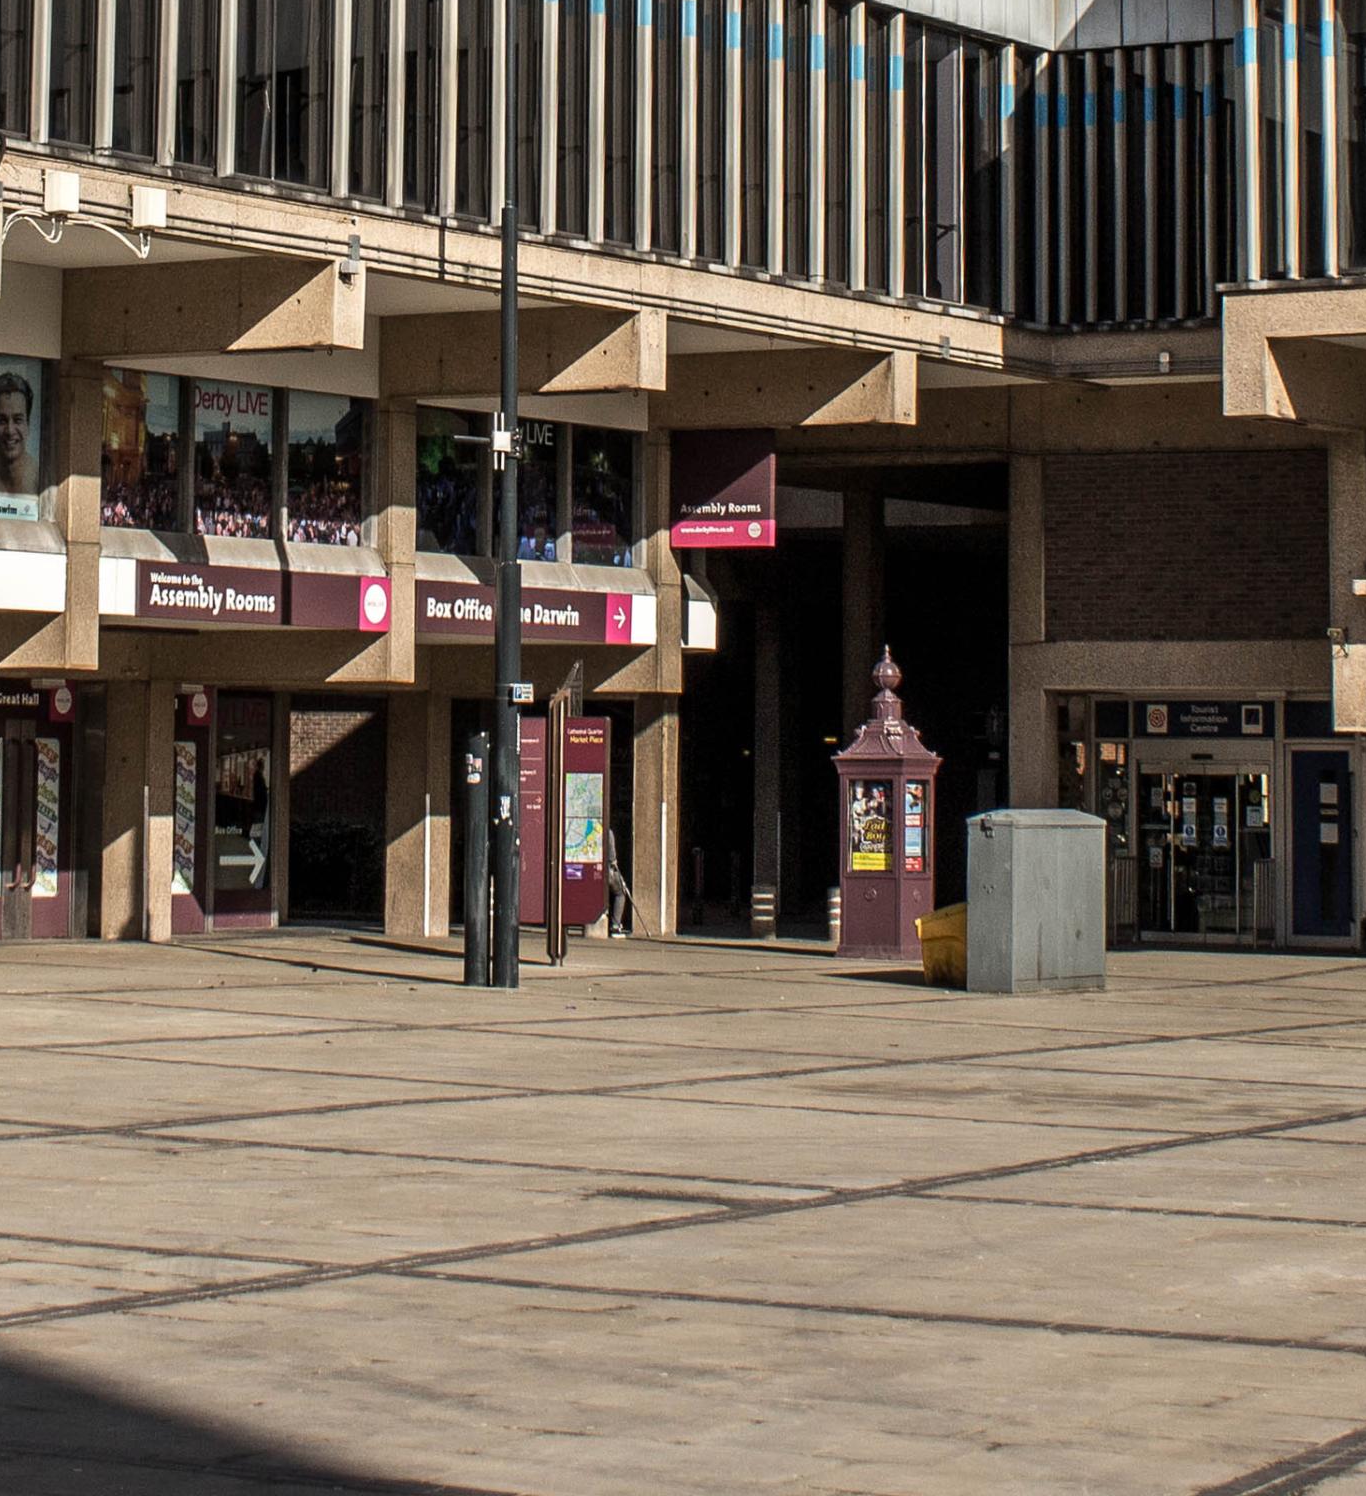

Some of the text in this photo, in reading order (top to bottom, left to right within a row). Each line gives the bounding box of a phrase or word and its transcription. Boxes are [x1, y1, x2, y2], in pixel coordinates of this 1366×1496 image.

[194, 385, 269, 417] Derby LIVE
[526, 421, 554, 446] LIVE
[680, 501, 761, 516] Assembly Rooms
[150, 572, 204, 586] Welcome to the
[150, 583, 276, 616] Assembly Rooms
[426, 597, 453, 619] Box
[453, 598, 492, 622] Office
[533, 603, 580, 627] Darwin
[21, 693, 40, 705] Hall
[1191, 704, 1219, 714] Tourist
[1179, 713, 1228, 723] Information
[1189, 722, 1219, 733] Centre
[569, 735, 604, 744] Market Place
